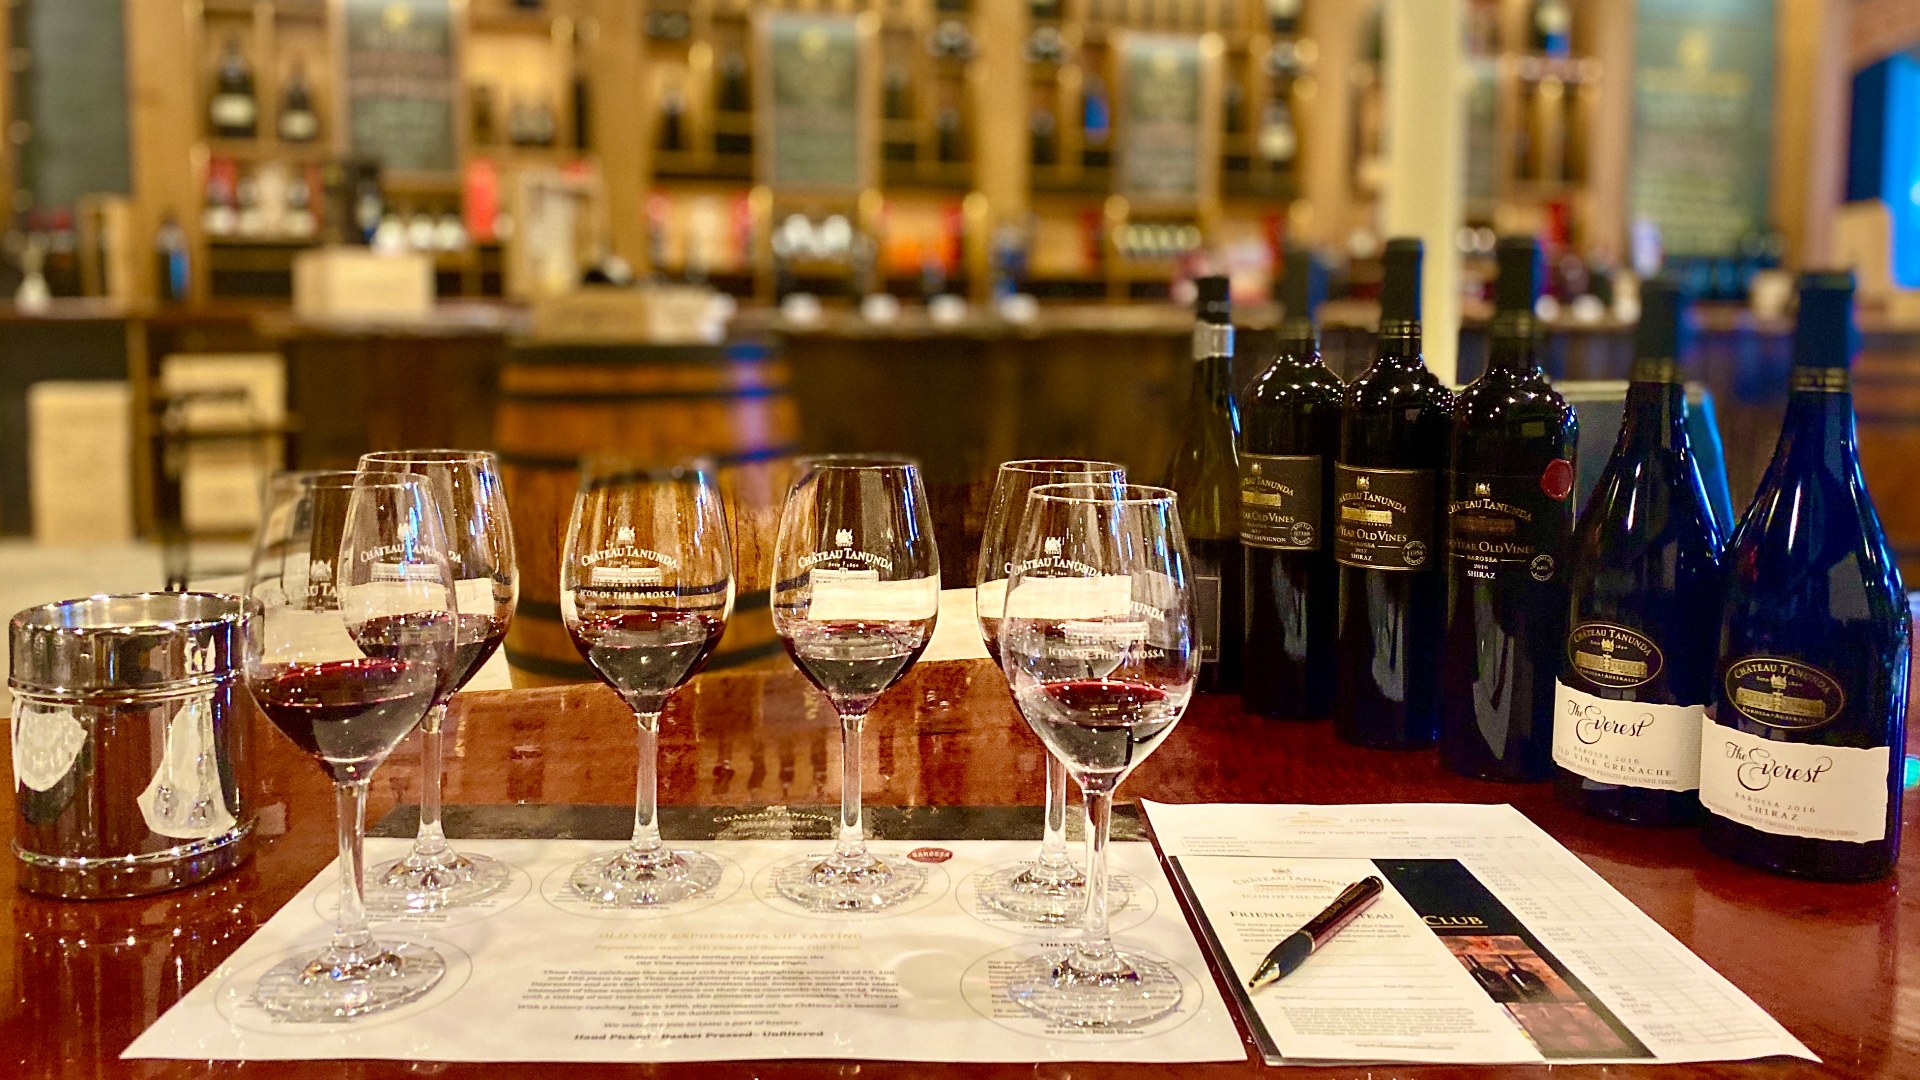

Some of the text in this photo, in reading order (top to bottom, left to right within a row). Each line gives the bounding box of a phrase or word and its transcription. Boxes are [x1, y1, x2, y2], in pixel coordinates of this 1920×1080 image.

[1257, 476, 1294, 496] TANUNDA
[1363, 491, 1406, 513] TANUNDA
[1483, 499, 1532, 521] TANUNDA
[1268, 512, 1295, 523] VINES
[1356, 528, 1377, 540] OLD
[1377, 530, 1407, 542] VINES
[360, 544, 404, 563] CHÂTEAU
[581, 545, 677, 568] CHÂTEAU TANUNDA
[1479, 541, 1504, 553] OLD
[798, 548, 892, 571] CHÂTEAU TANUNDA
[1351, 553, 1372, 561] SHIRAZ
[1467, 555, 1498, 563] BAROSSA
[1467, 570, 1496, 579] SHIRAZ
[580, 589, 676, 599] ICON OF THE BAROSSA
[1049, 647, 1074, 657] ICON
[1609, 629, 1652, 656] TANUNDA
[1734, 664, 1830, 694] CHÂTEAU TANUNDA
[1567, 699, 1655, 745] The Everest
[1573, 745, 1639, 764] BAROSSA 2016
[1573, 752, 1598, 766] VINE
[1603, 761, 1672, 776] GRENACHE
[1726, 741, 1833, 791] The Everest
[1735, 791, 1816, 814] BAROSSA 2016
[1748, 804, 1799, 821] SHIRAZ
[911, 850, 950, 858] BAROSSA
[1287, 875, 1347, 887] TANUNDA
[1421, 915, 1484, 925] CLUB
